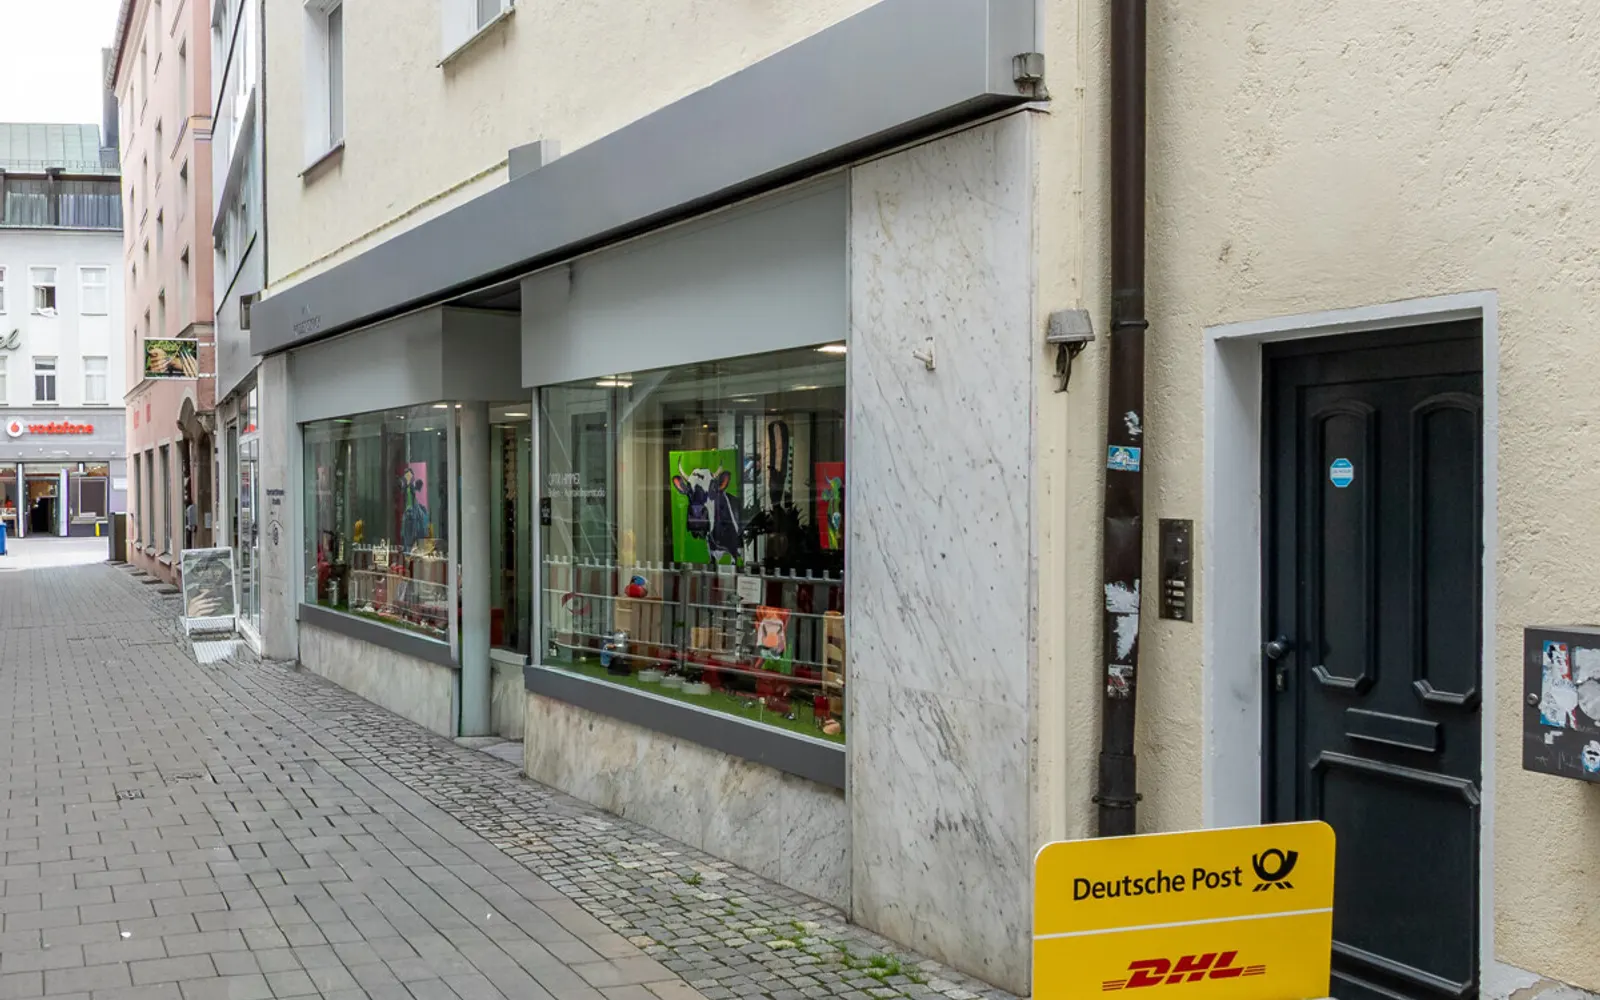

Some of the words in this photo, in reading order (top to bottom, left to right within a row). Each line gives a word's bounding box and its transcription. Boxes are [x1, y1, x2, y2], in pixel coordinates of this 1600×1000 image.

[28, 421, 94, 436] vodafone
[1072, 869, 1185, 901] Deutsche
[1191, 866, 1243, 890] Post
[1124, 950, 1244, 989] DHL
